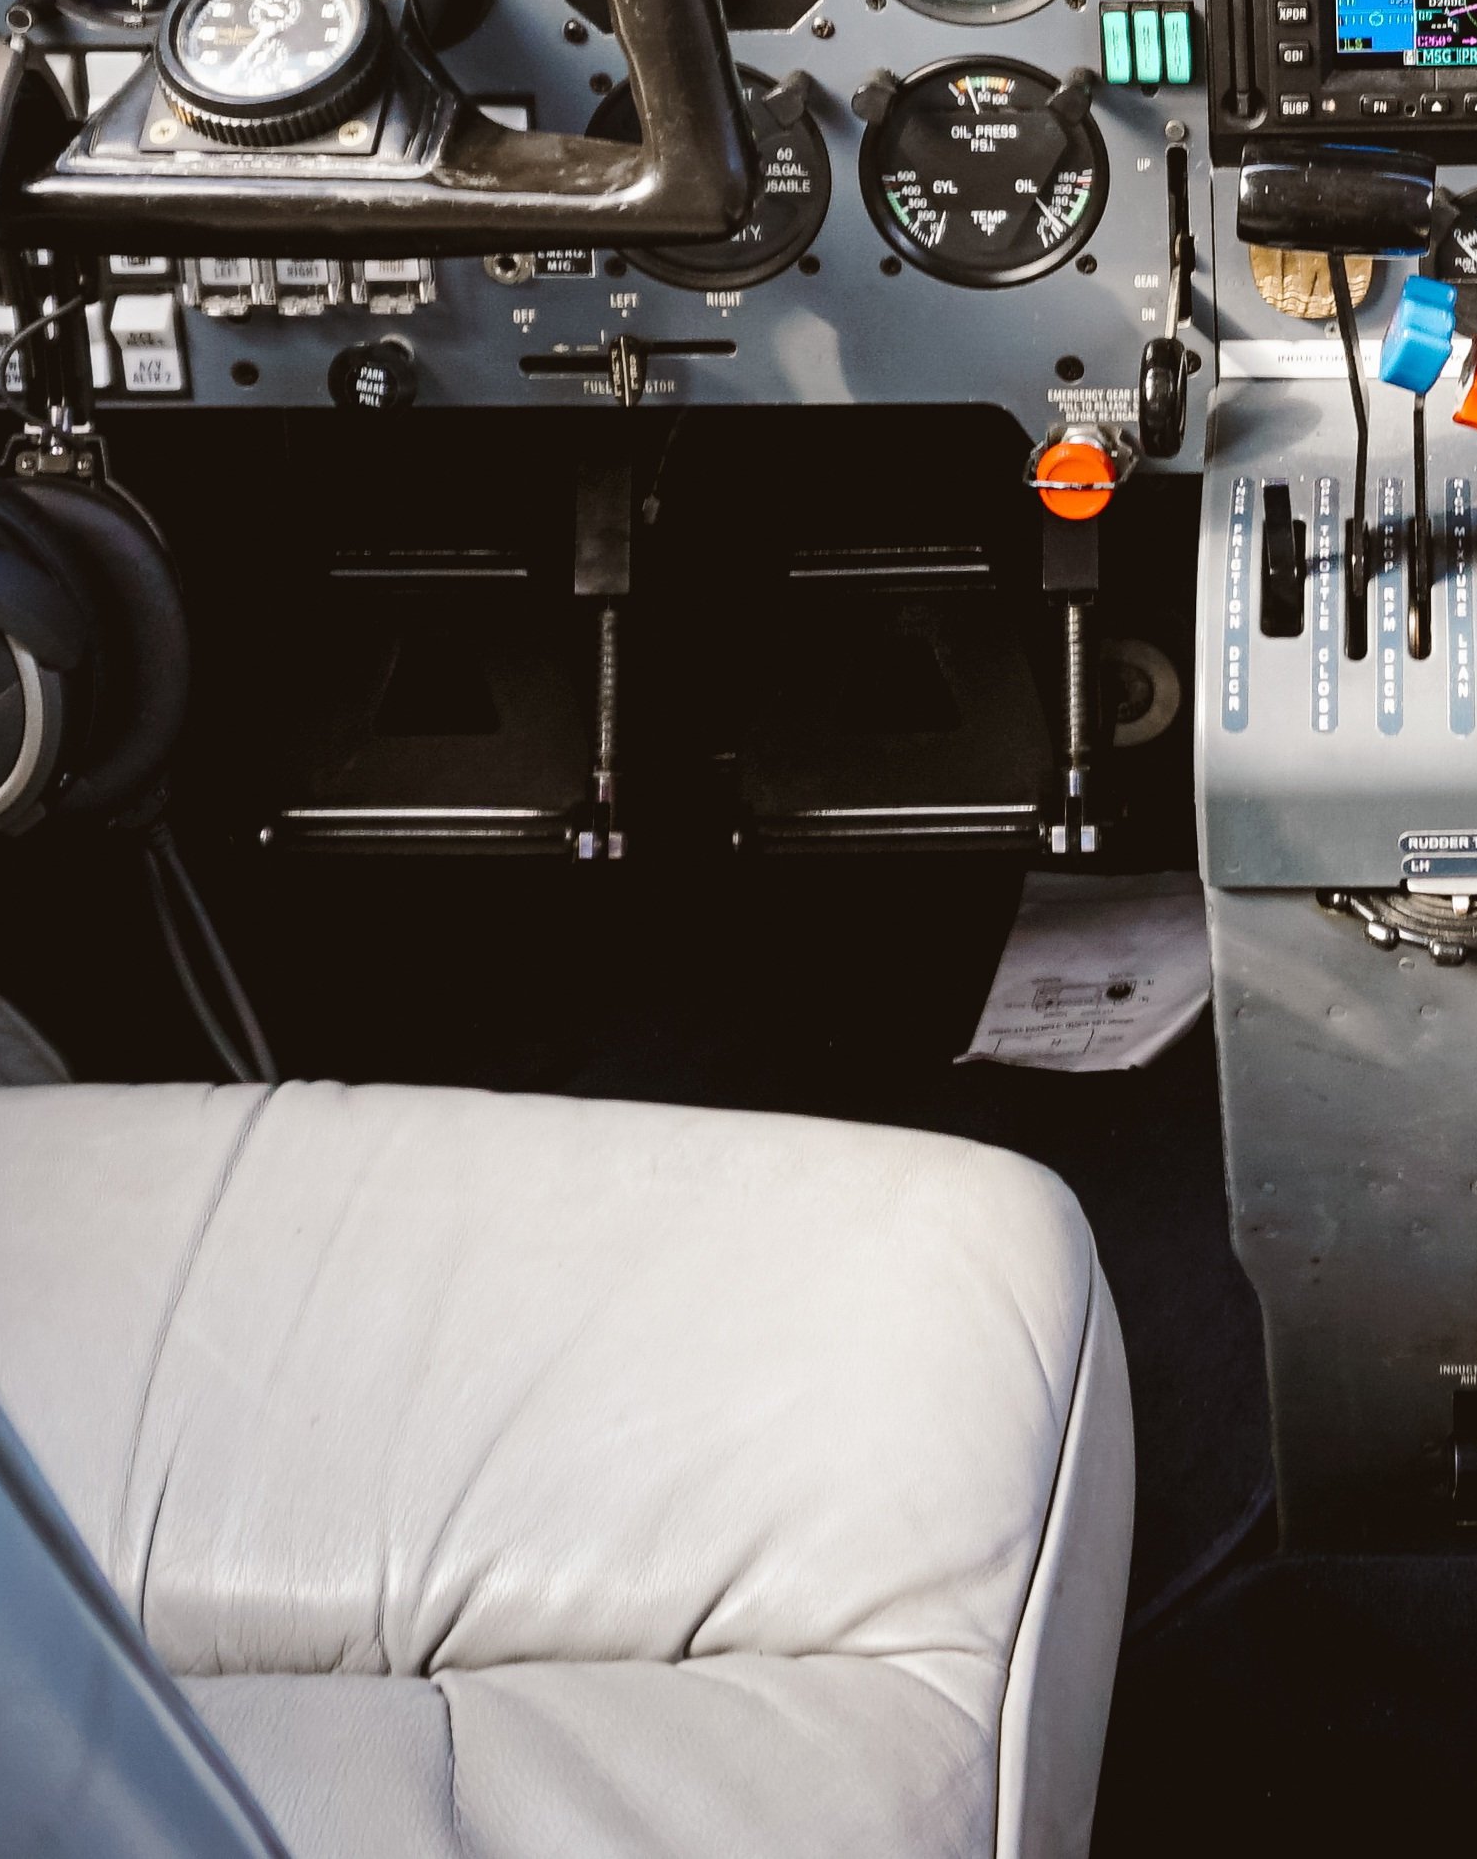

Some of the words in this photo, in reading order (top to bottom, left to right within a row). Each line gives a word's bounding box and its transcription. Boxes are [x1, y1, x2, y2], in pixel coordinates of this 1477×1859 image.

[1422, 49, 1451, 65] MSG
[951, 125, 971, 139] OIL
[975, 124, 1017, 140] PRESS
[933, 180, 958, 195] CYL
[971, 210, 1007, 225] TEMP
[1134, 275, 1160, 289] GEAR
[610, 294, 638, 308] LEFT
[706, 292, 742, 307] RIGHT
[1319, 524, 1331, 631] THROTTLE
[1383, 586, 1396, 631] RPM
[1457, 633, 1469, 698] LEAN
[1318, 648, 1330, 731] CLOSE
[1408, 836, 1469, 850] RUDDER
[1411, 859, 1430, 873] LH
